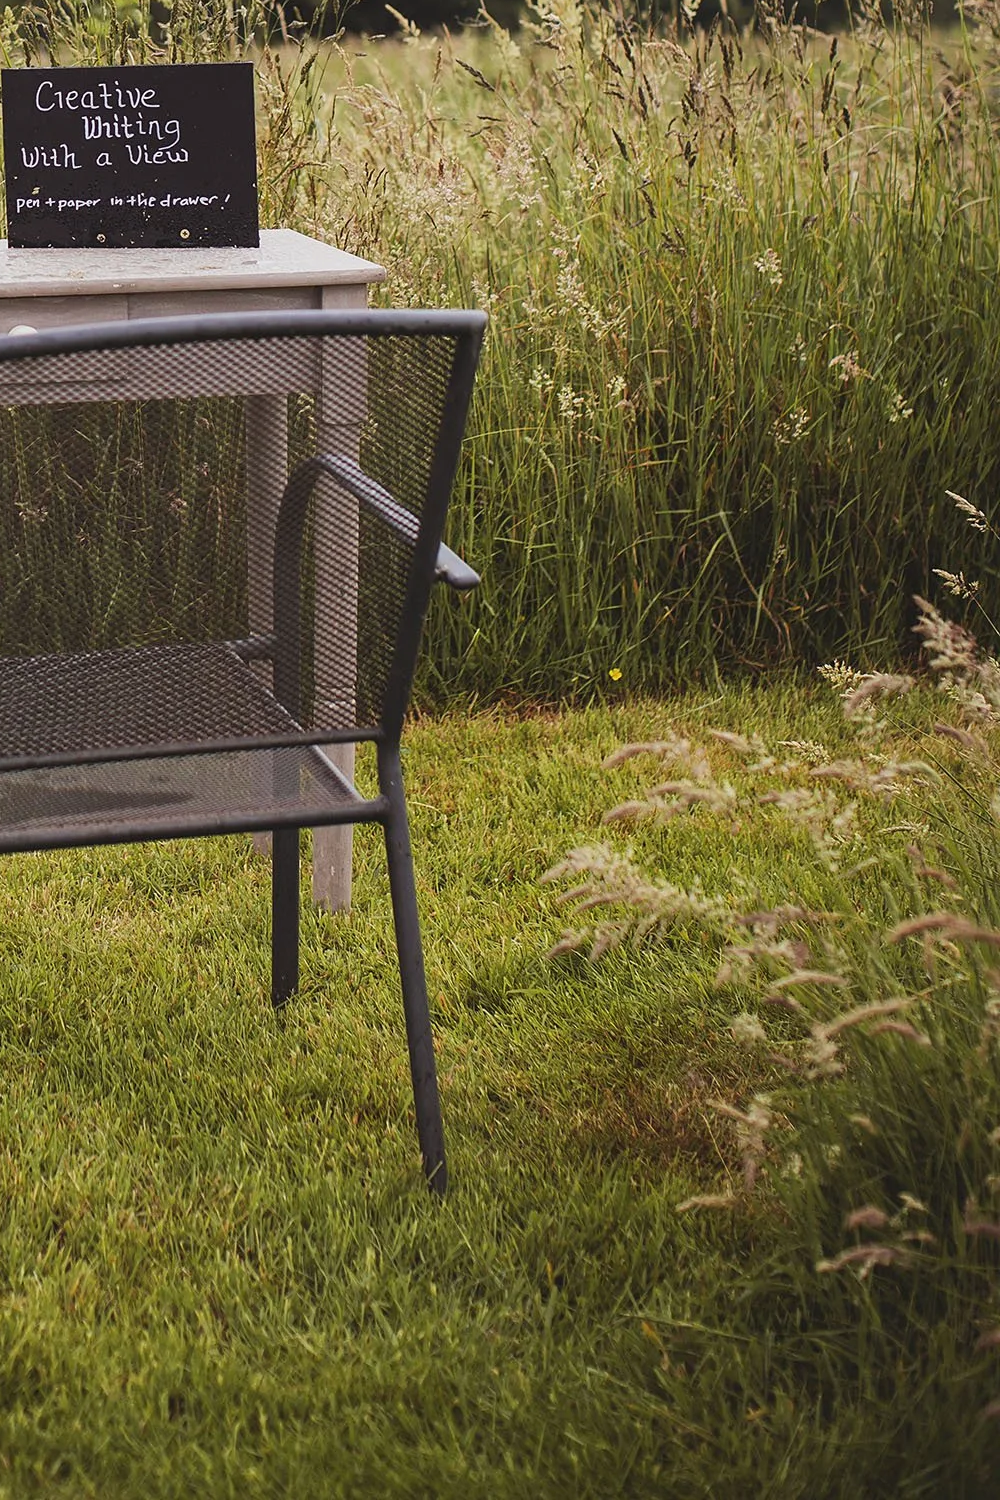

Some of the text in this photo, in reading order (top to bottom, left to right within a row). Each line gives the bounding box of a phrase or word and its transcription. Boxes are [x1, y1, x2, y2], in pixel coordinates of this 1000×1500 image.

[35, 80, 161, 112] Creative
[82, 112, 181, 150] Writing
[96, 151, 112, 166] a
[125, 145, 189, 165] View
[16, 196, 40, 213] pen
[110, 196, 123, 206] in
[127, 192, 155, 207] the
